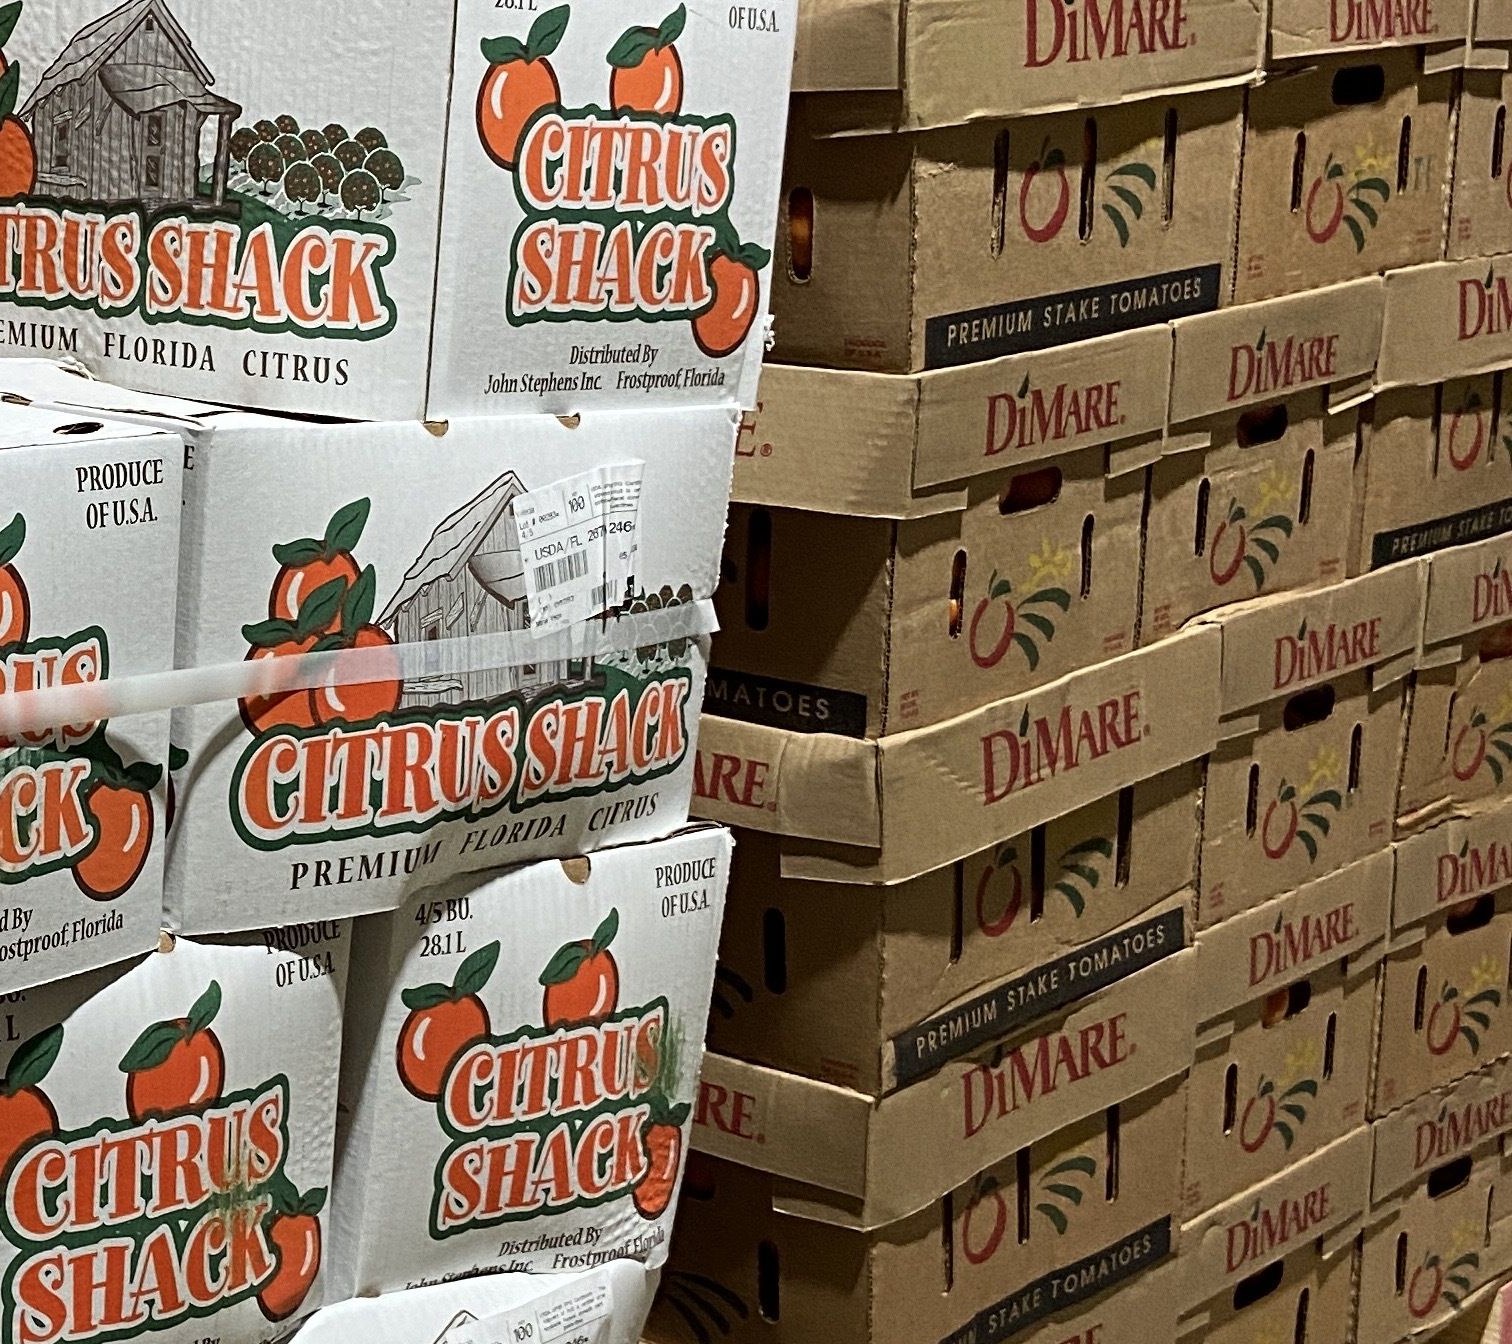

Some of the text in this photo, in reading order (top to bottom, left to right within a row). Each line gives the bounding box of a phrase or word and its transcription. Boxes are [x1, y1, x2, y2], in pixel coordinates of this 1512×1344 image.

[518, 111, 731, 213] CITRUS
[149, 221, 386, 331] SHACK
[518, 221, 714, 316] SHACK
[947, 276, 1203, 347] PREMIUM STAKE TOMATOES
[103, 333, 215, 373] FLORIDA
[243, 349, 350, 387] CITRUS
[1227, 327, 1338, 403] DiMARE
[985, 370, 1121, 457] DiMARE
[76, 459, 164, 492] PRODUCE
[86, 502, 112, 529] OF
[1273, 617, 1382, 692] DiMARE
[243, 678, 689, 832] CITRUS SHACK
[980, 702, 1142, 807] DiMARE
[291, 793, 660, 890] PREMIUM FLORIDA CITRUS
[655, 857, 716, 888] PRODUCE
[11, 906, 34, 933] By
[71, 911, 125, 945] Florida
[1248, 900, 1355, 989] DiMARE
[916, 923, 1168, 1060] PREMIUM STAKE TOMATOES
[448, 1014, 665, 1130] CITRUS
[9, 1096, 283, 1239] CITRUS
[444, 1113, 646, 1222] SHACK
[1225, 1181, 1332, 1276] DiMARE
[986, 1230, 1154, 1337] STAKE TOMATOES
